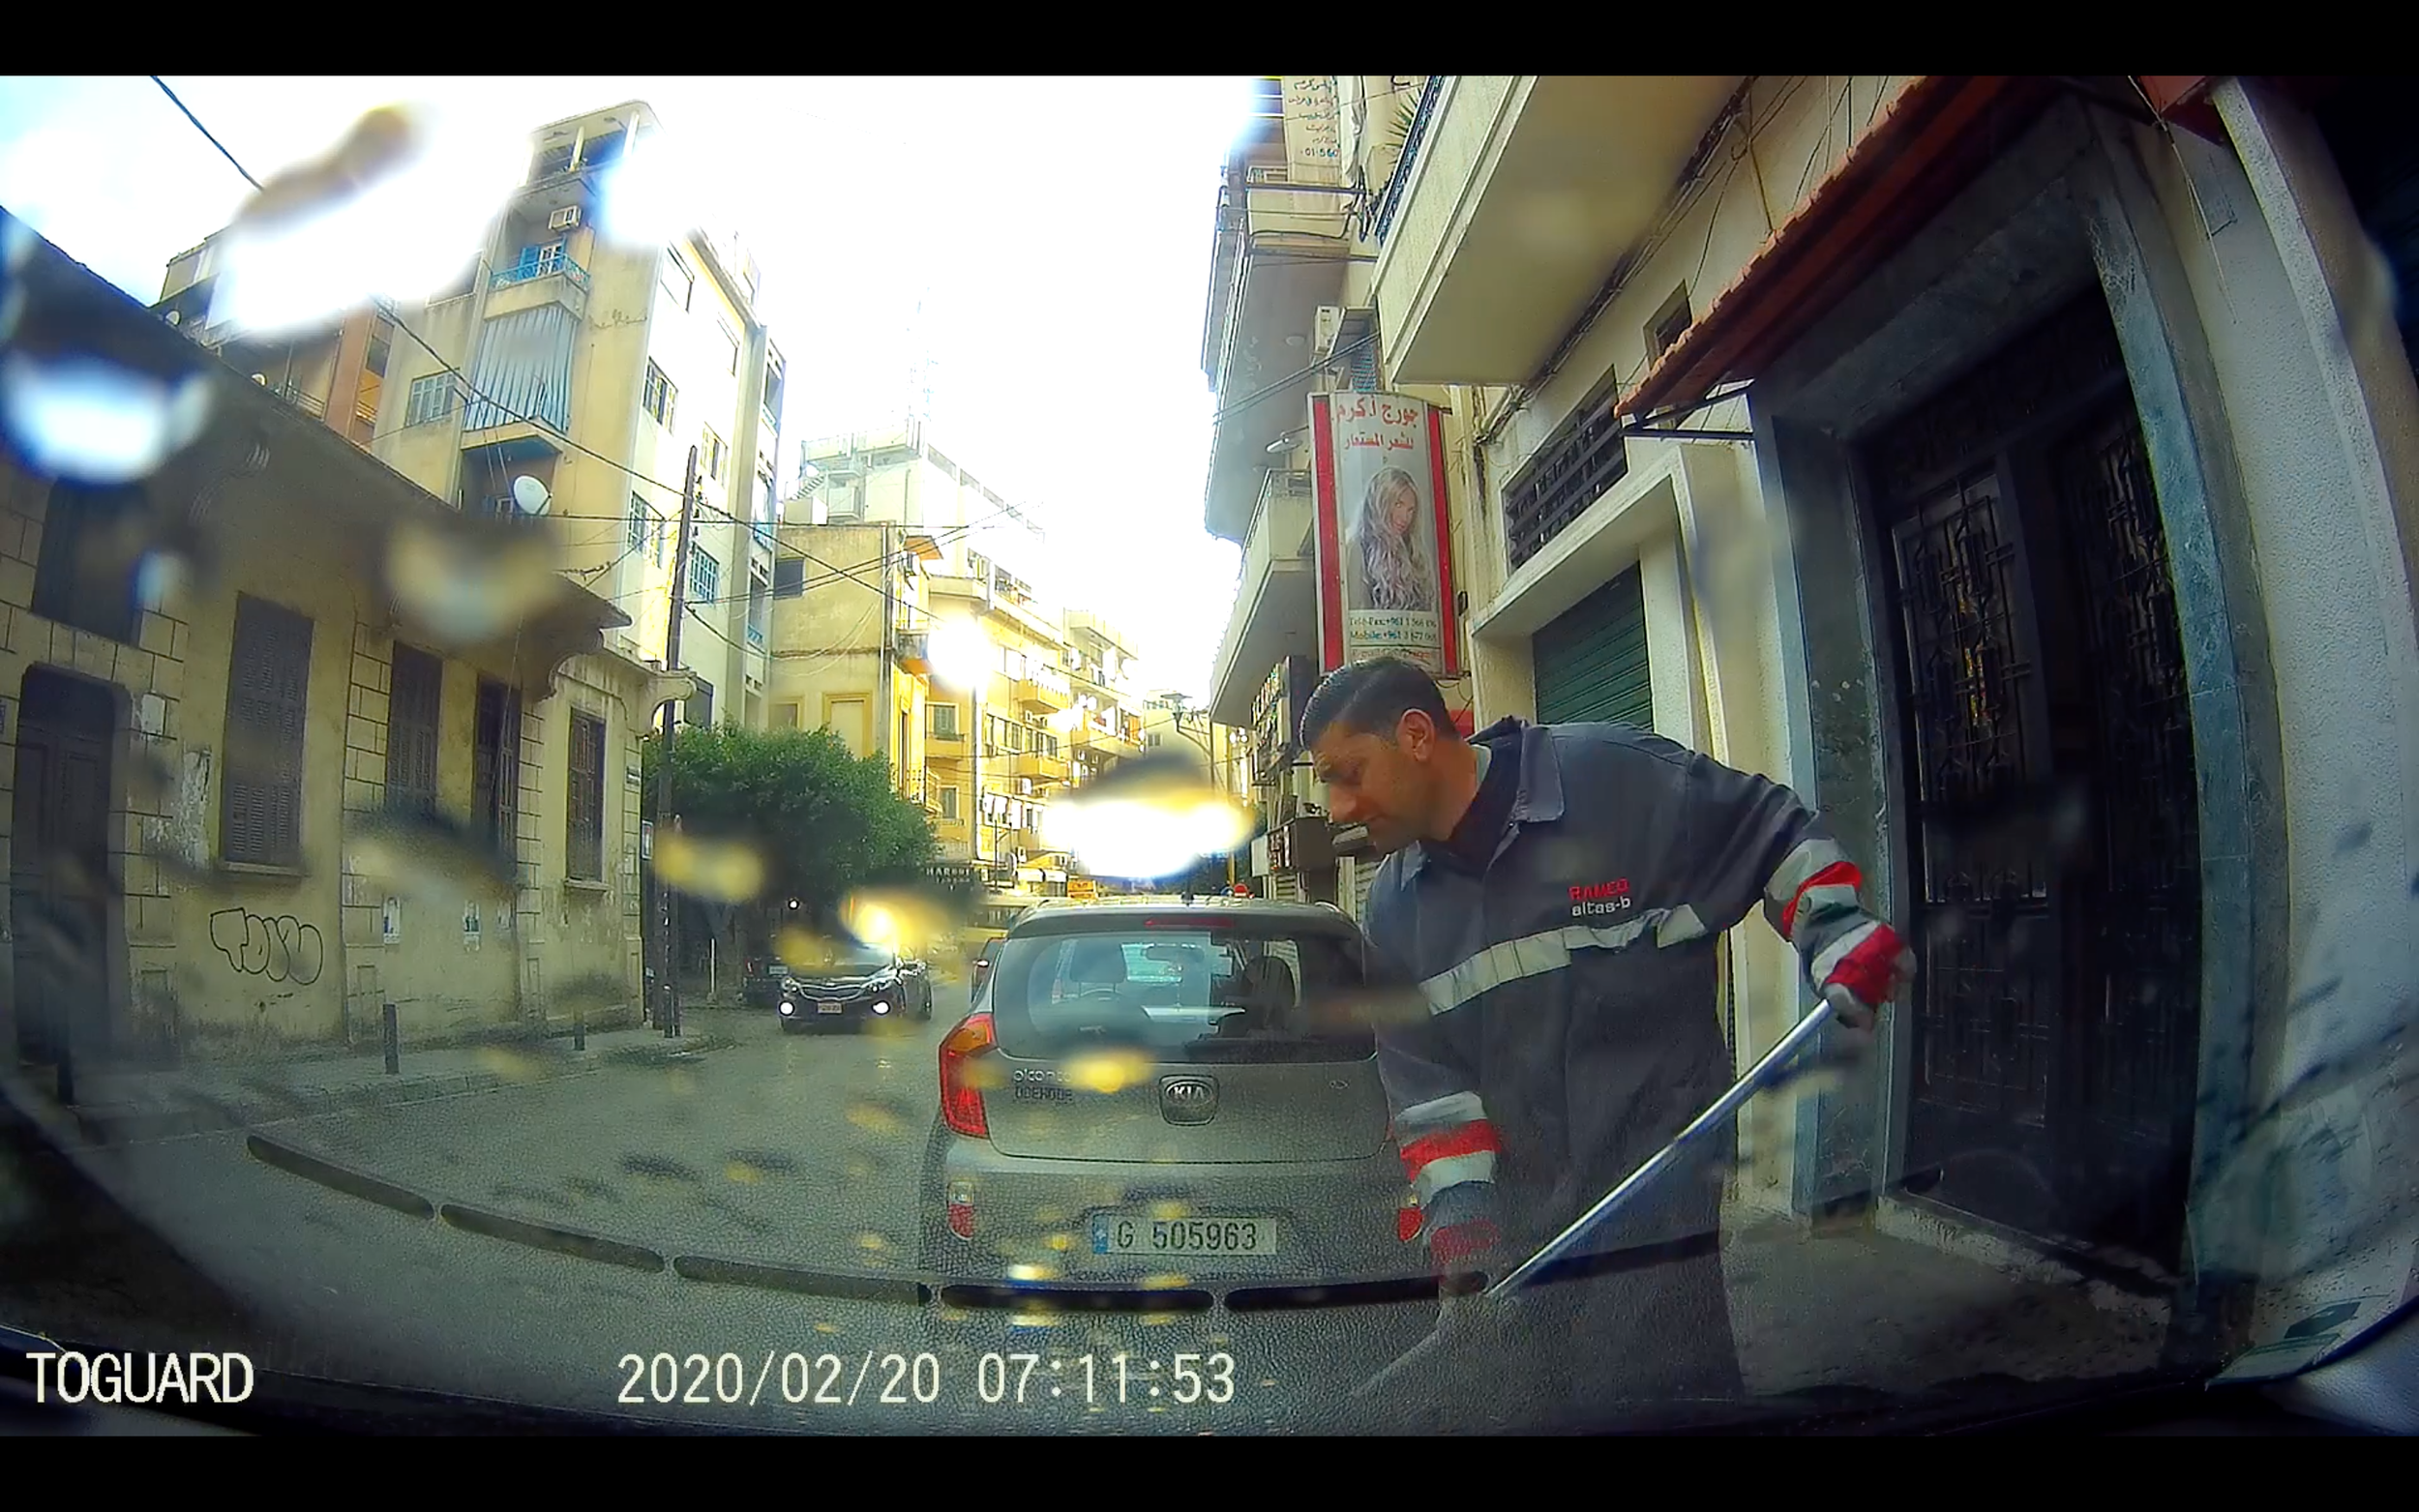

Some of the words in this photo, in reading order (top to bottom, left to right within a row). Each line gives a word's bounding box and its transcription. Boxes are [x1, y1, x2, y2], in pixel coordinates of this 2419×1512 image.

[1381, 403, 1419, 429] جورج
[1172, 1085, 1205, 1101] KIA
[1117, 1221, 1135, 1249] G
[1152, 1221, 1257, 1251] 505963
